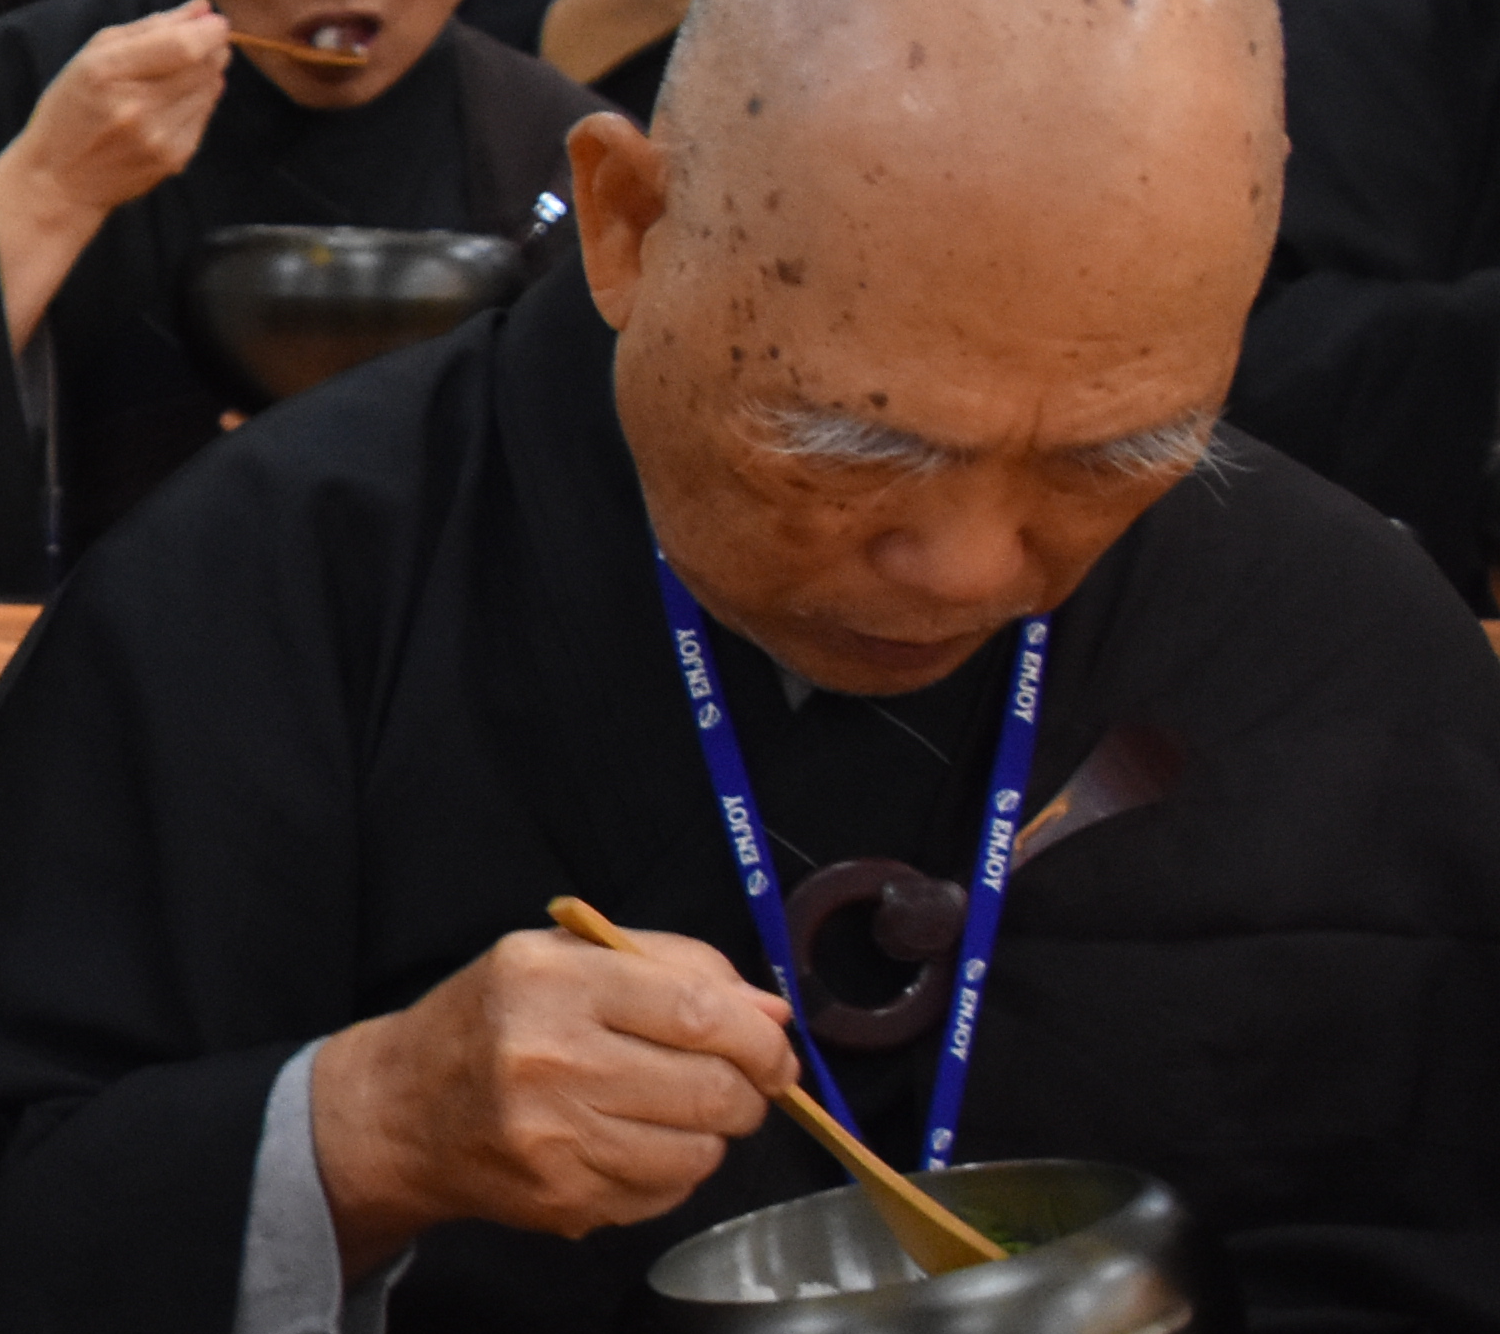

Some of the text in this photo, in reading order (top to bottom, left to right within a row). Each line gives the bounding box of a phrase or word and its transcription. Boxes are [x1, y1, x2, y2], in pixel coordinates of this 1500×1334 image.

[675, 628, 713, 700] ENJOY
[1013, 650, 1043, 724] ENJOY
[721, 794, 761, 866] ENJOY
[981, 817, 1014, 894] ENJOY
[949, 986, 979, 1062] ENJOY
